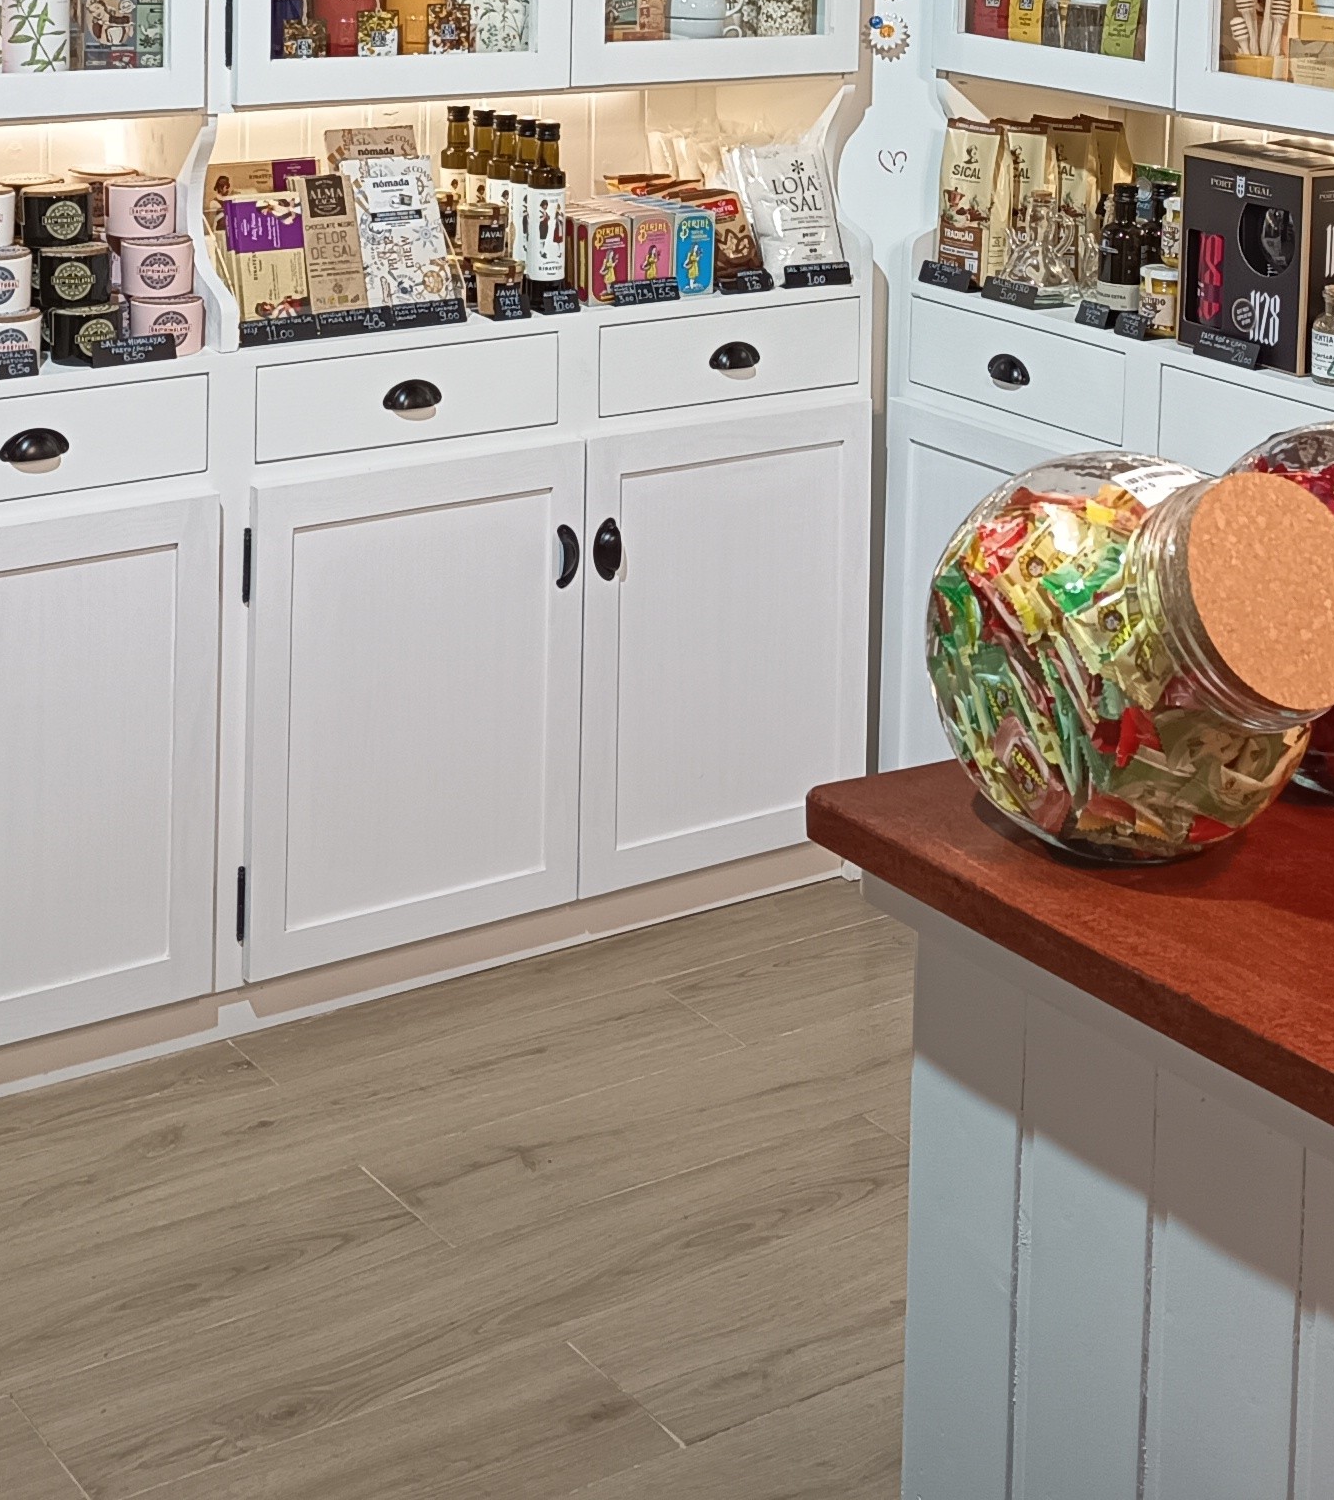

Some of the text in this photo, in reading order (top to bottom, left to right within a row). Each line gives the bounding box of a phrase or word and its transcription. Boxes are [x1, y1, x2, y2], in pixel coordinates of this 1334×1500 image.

[952, 164, 982, 180] SICAL
[372, 179, 409, 189] nómada
[772, 175, 819, 195] LOJA
[1211, 178, 1272, 196] PORT UGAL
[309, 188, 343, 199] ALMA
[789, 194, 822, 213] SAL
[305, 222, 336, 231] CHOCOLATE
[316, 230, 348, 244] FLOR
[944, 228, 974, 242] TRADIÇÃO
[311, 245, 356, 260] DE SAL
[807, 272, 826, 285] 1.00
[439, 311, 459, 322] 9.00
[1249, 290, 1280, 347] 1128
[266, 325, 294, 341] 11.00
[128, 337, 166, 346] HIMALAYAS
[123, 352, 145, 361] 6.50
[8, 364, 30, 375] 6.50
